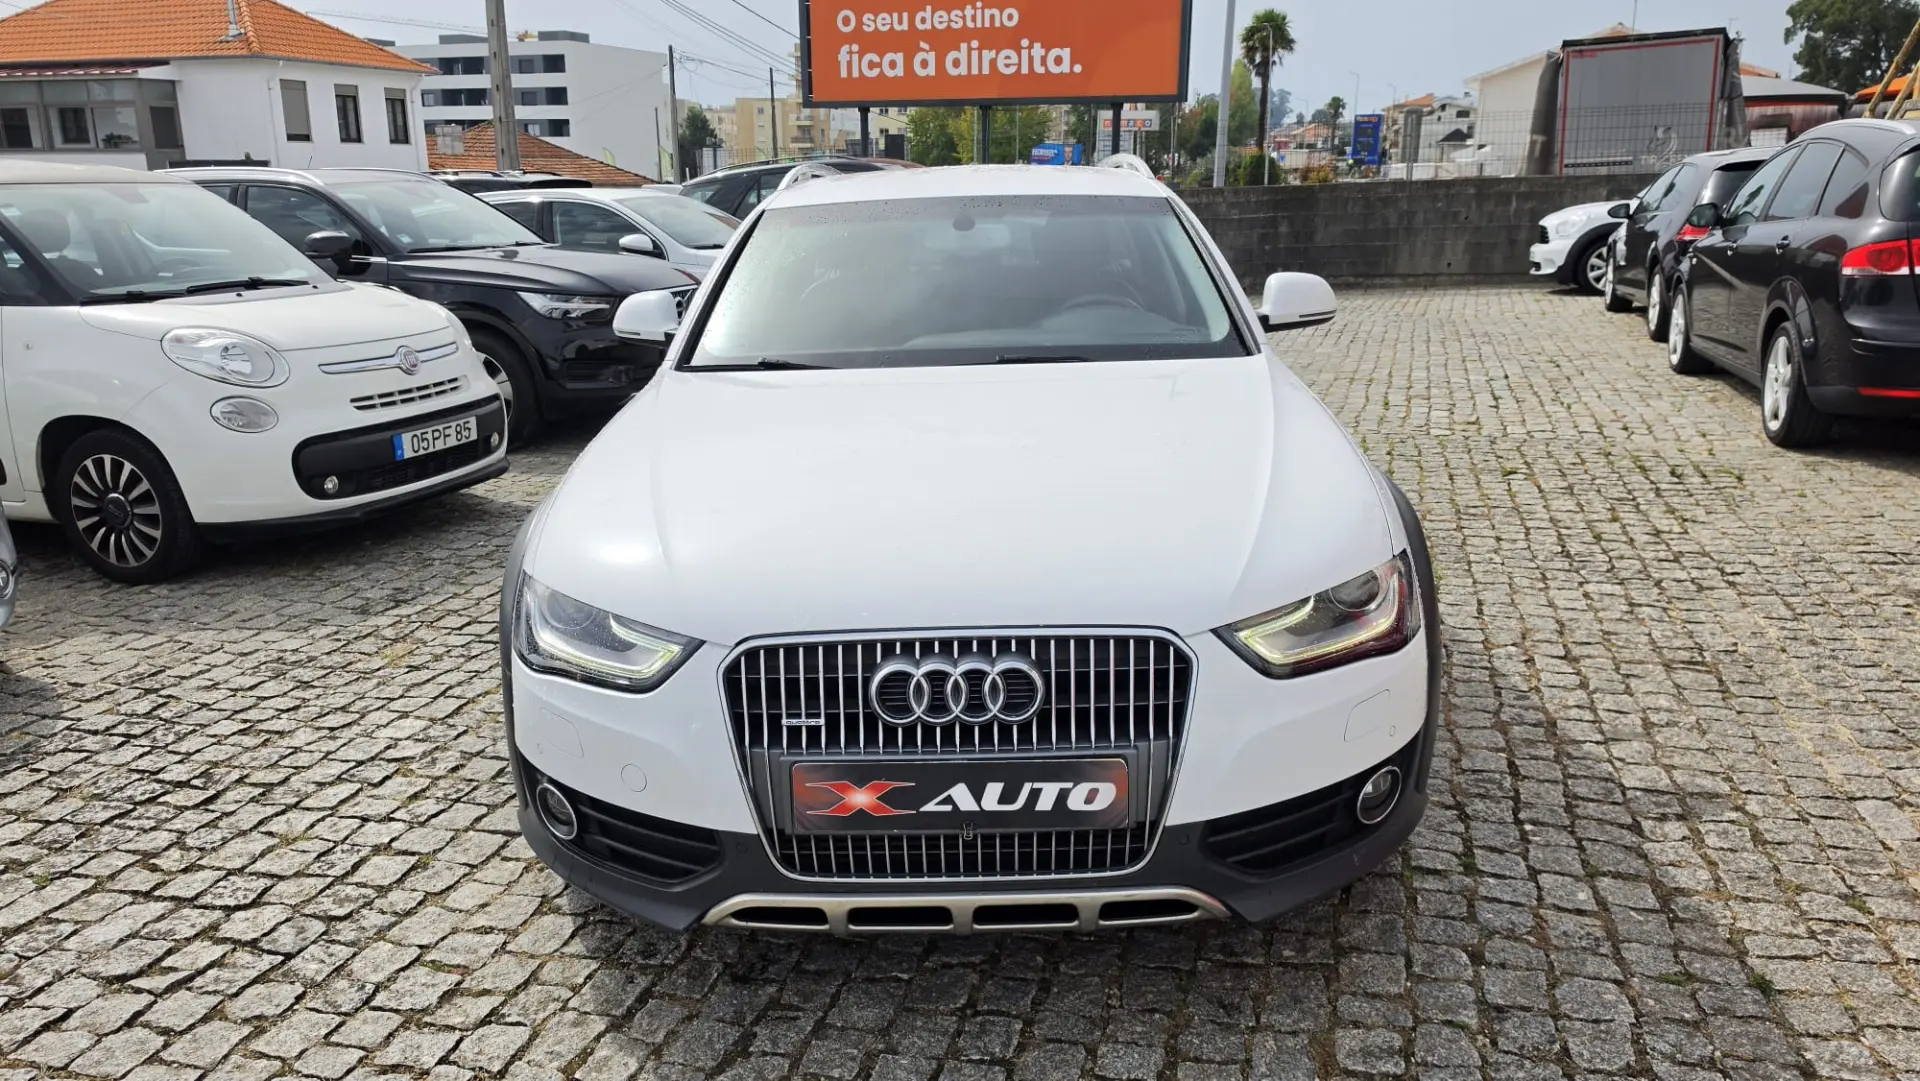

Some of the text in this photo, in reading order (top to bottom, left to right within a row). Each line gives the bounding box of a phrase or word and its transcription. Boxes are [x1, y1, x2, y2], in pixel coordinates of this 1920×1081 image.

[837, 1, 1019, 33] O seu destino
[838, 38, 1083, 78] fica à direita.
[919, 782, 1117, 812] AUTO
